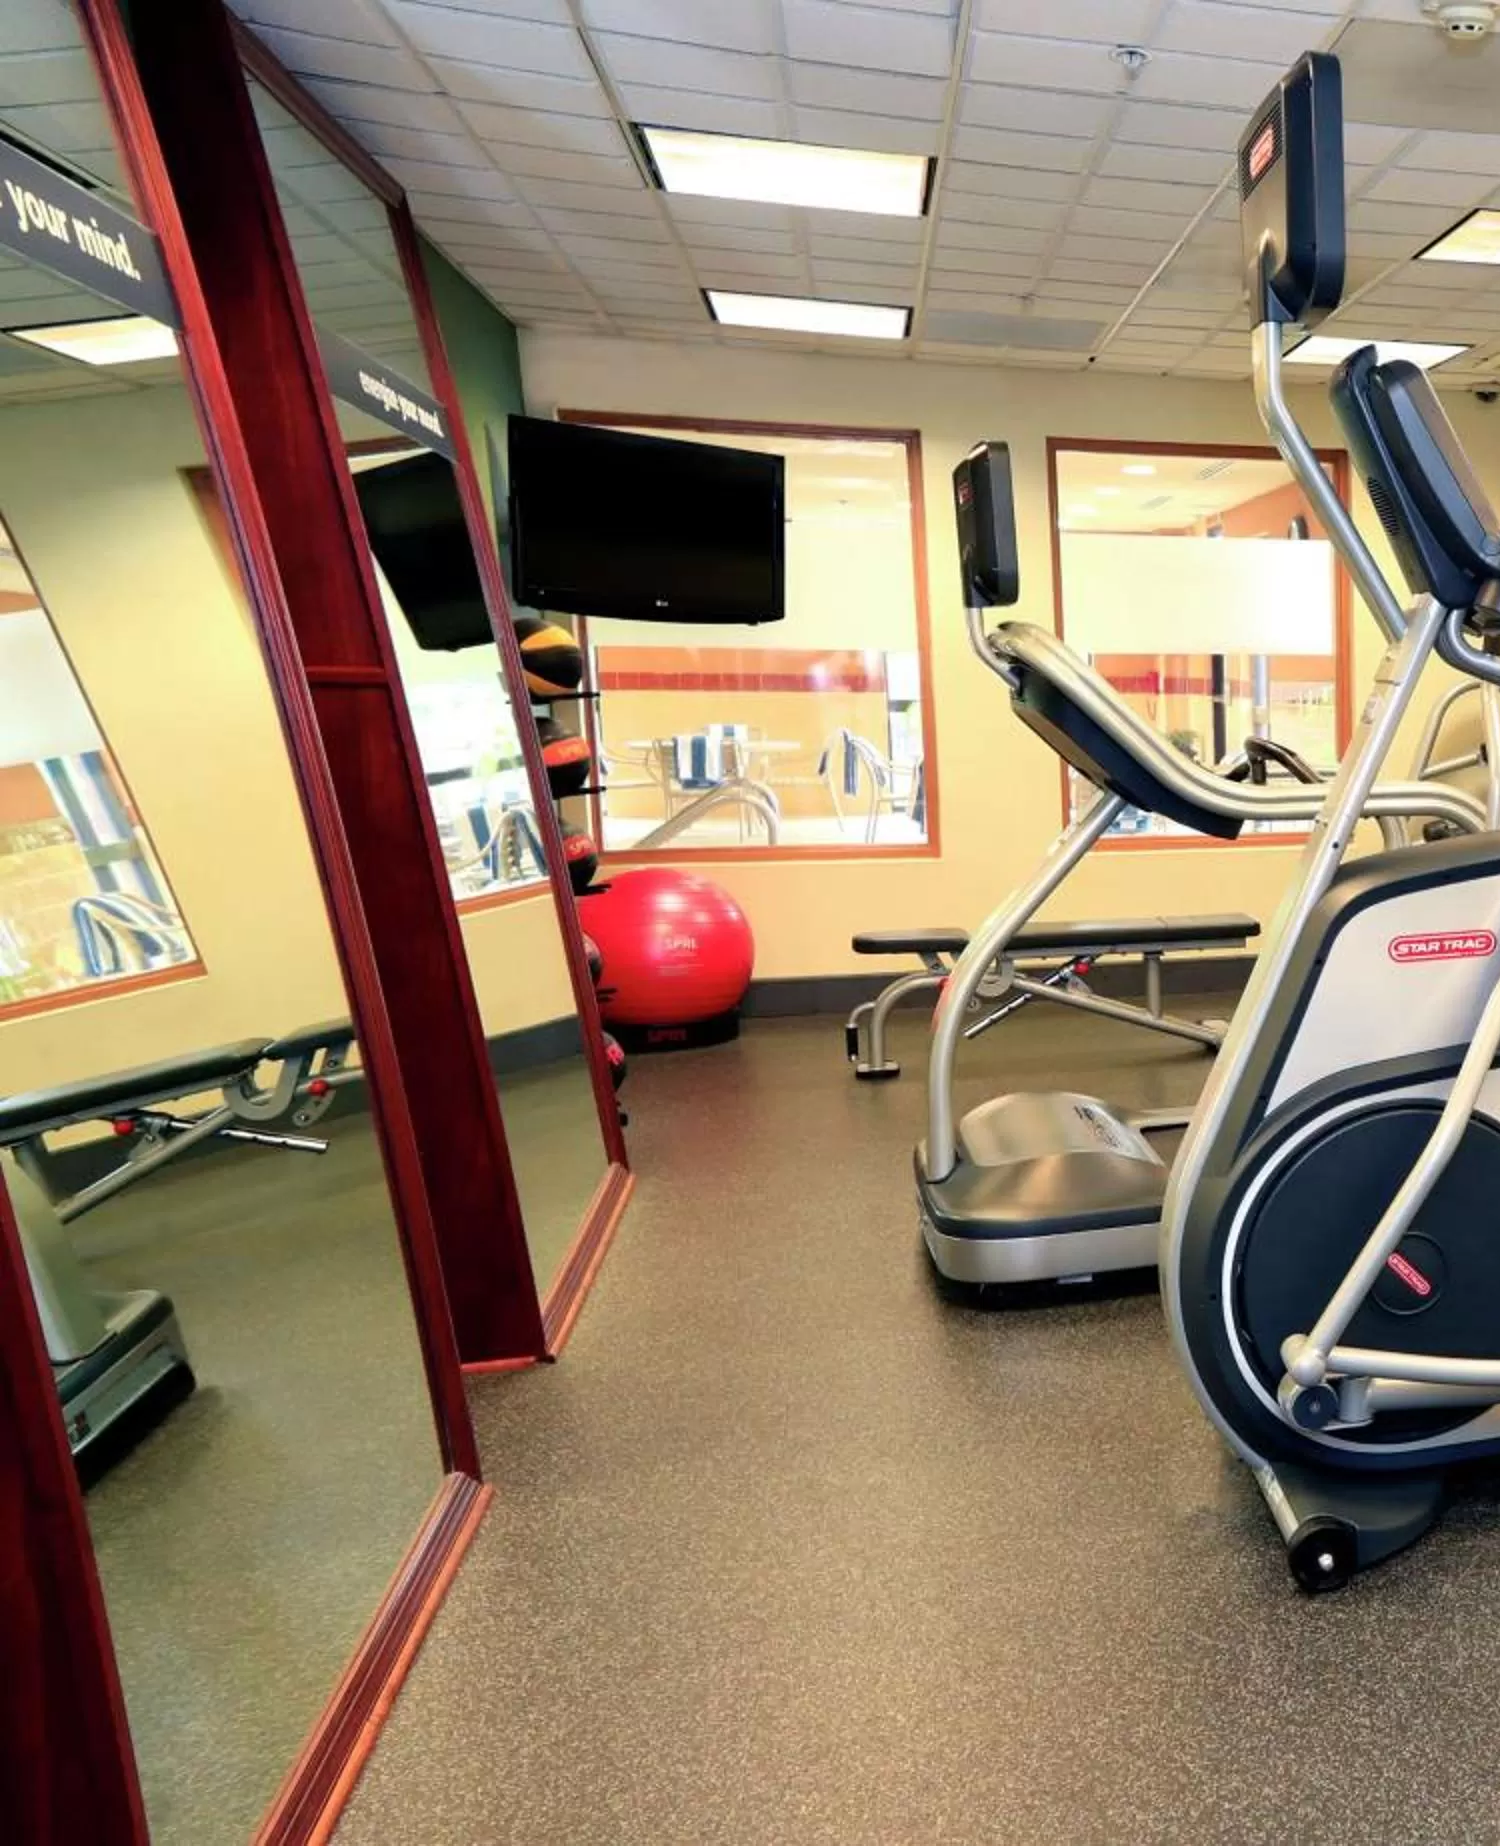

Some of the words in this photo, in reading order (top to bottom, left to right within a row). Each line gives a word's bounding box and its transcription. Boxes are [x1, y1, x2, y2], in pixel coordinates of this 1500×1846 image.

[4, 179, 70, 243] your
[72, 216, 141, 281] mind.
[1398, 942, 1440, 953] STAR
[1443, 938, 1487, 951] TRAC
